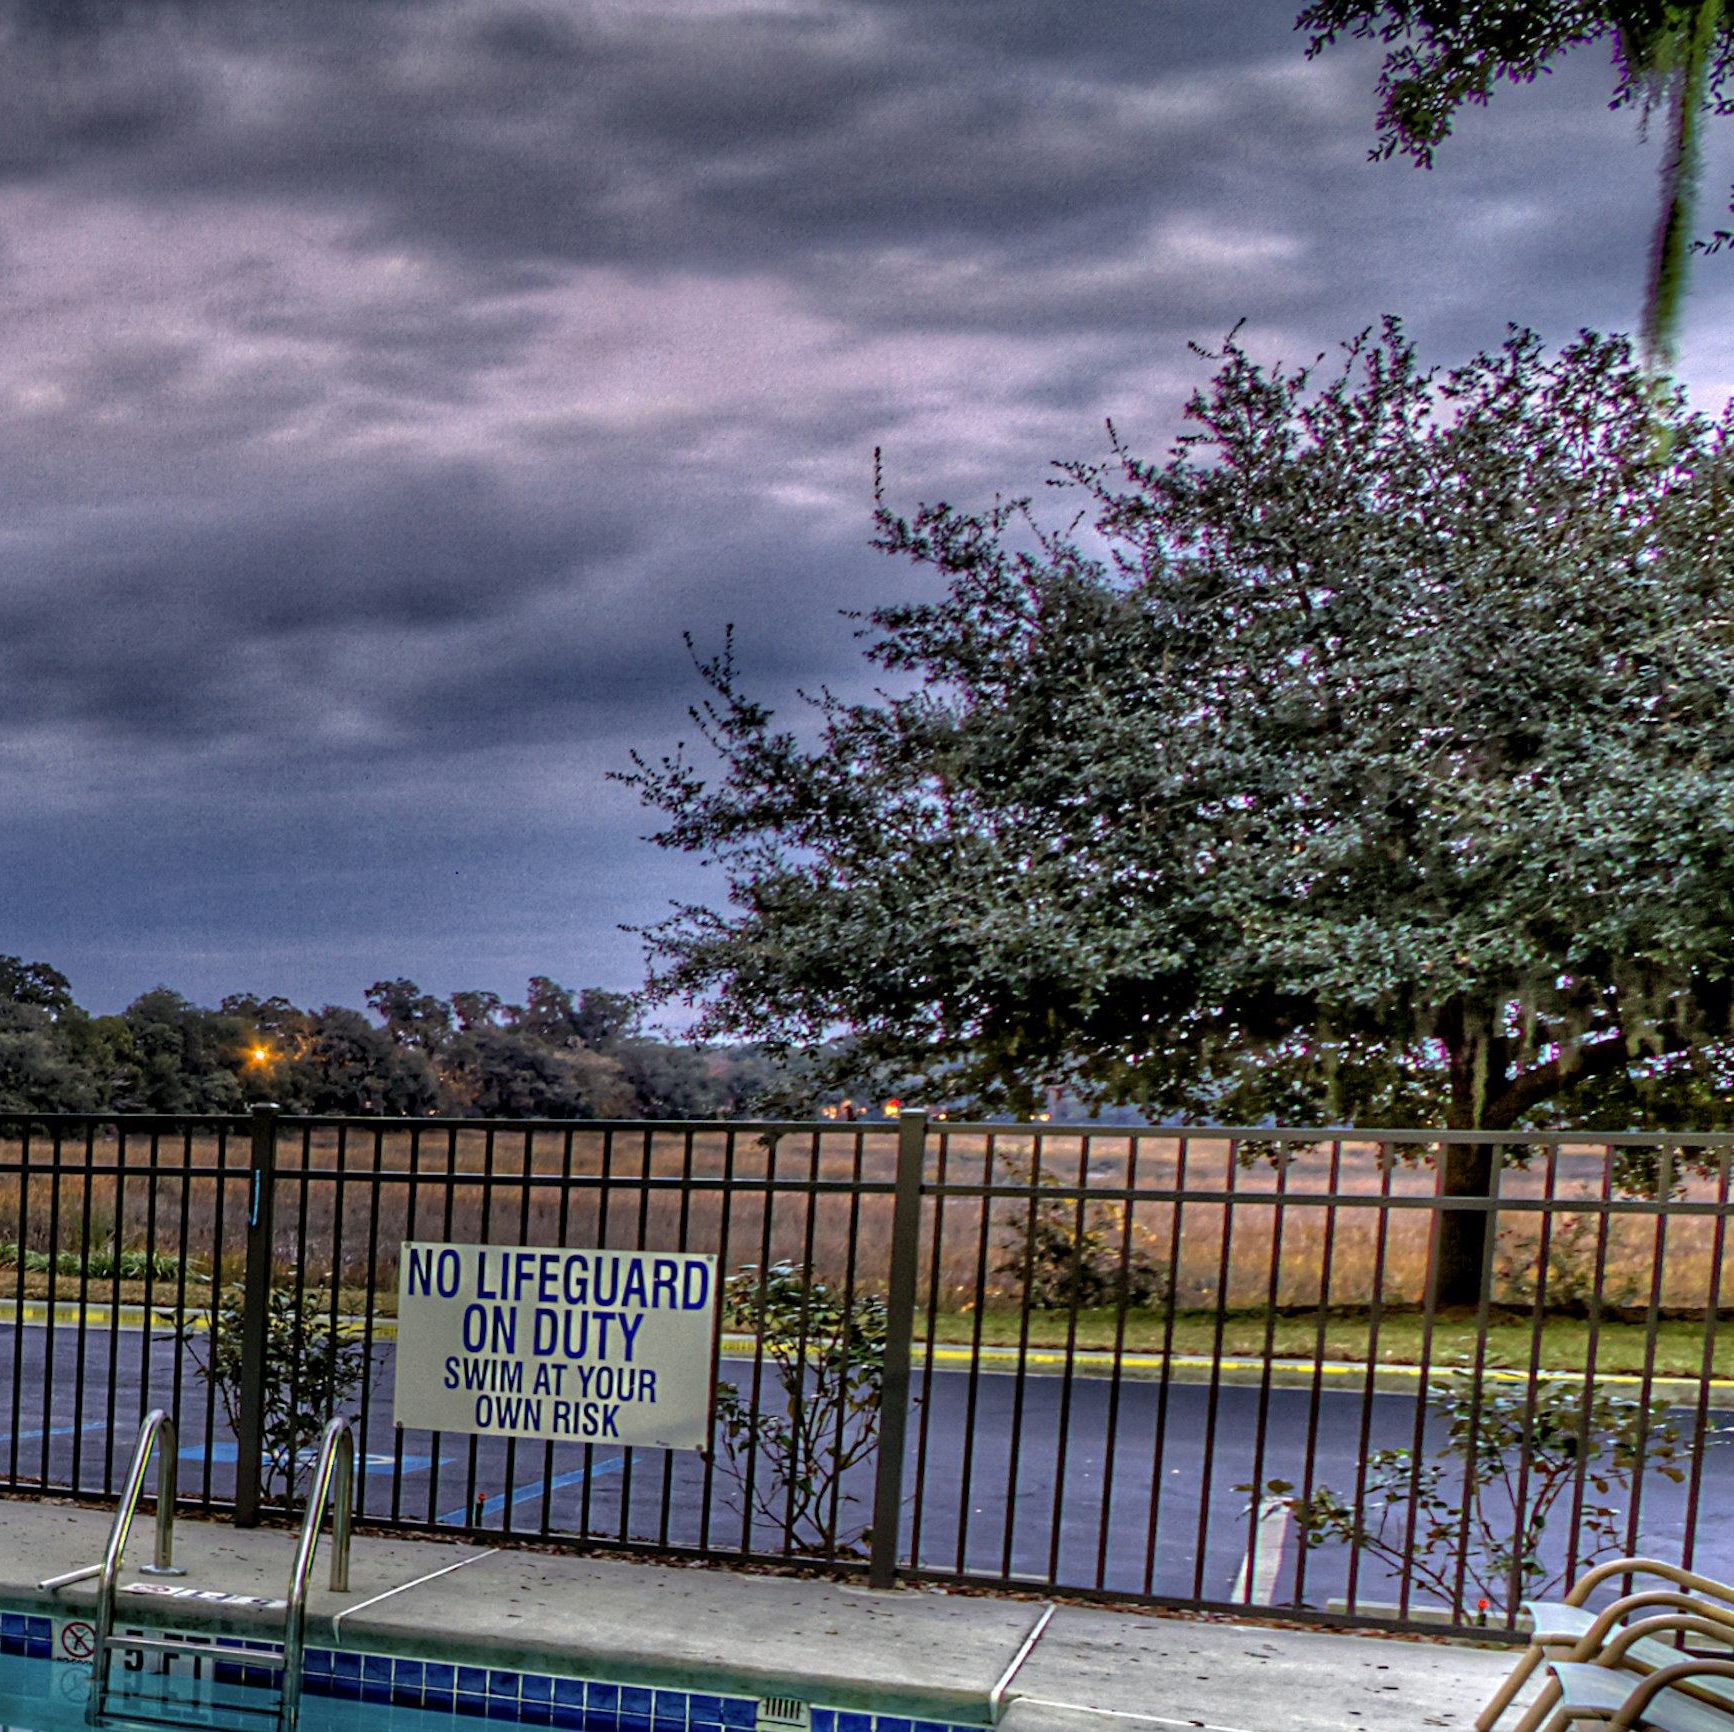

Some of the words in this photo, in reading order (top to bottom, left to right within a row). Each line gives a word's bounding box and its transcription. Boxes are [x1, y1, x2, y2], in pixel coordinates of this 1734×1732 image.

[408, 1248, 460, 1298] NO
[477, 1251, 709, 1311] LIFEGUARD
[463, 1303, 517, 1356] ON
[533, 1308, 644, 1362] DUTY
[444, 1356, 523, 1395] SWIM
[533, 1362, 567, 1397] AT
[578, 1365, 656, 1403] YOUR
[475, 1395, 541, 1432] OWN
[552, 1401, 620, 1438] RISK
